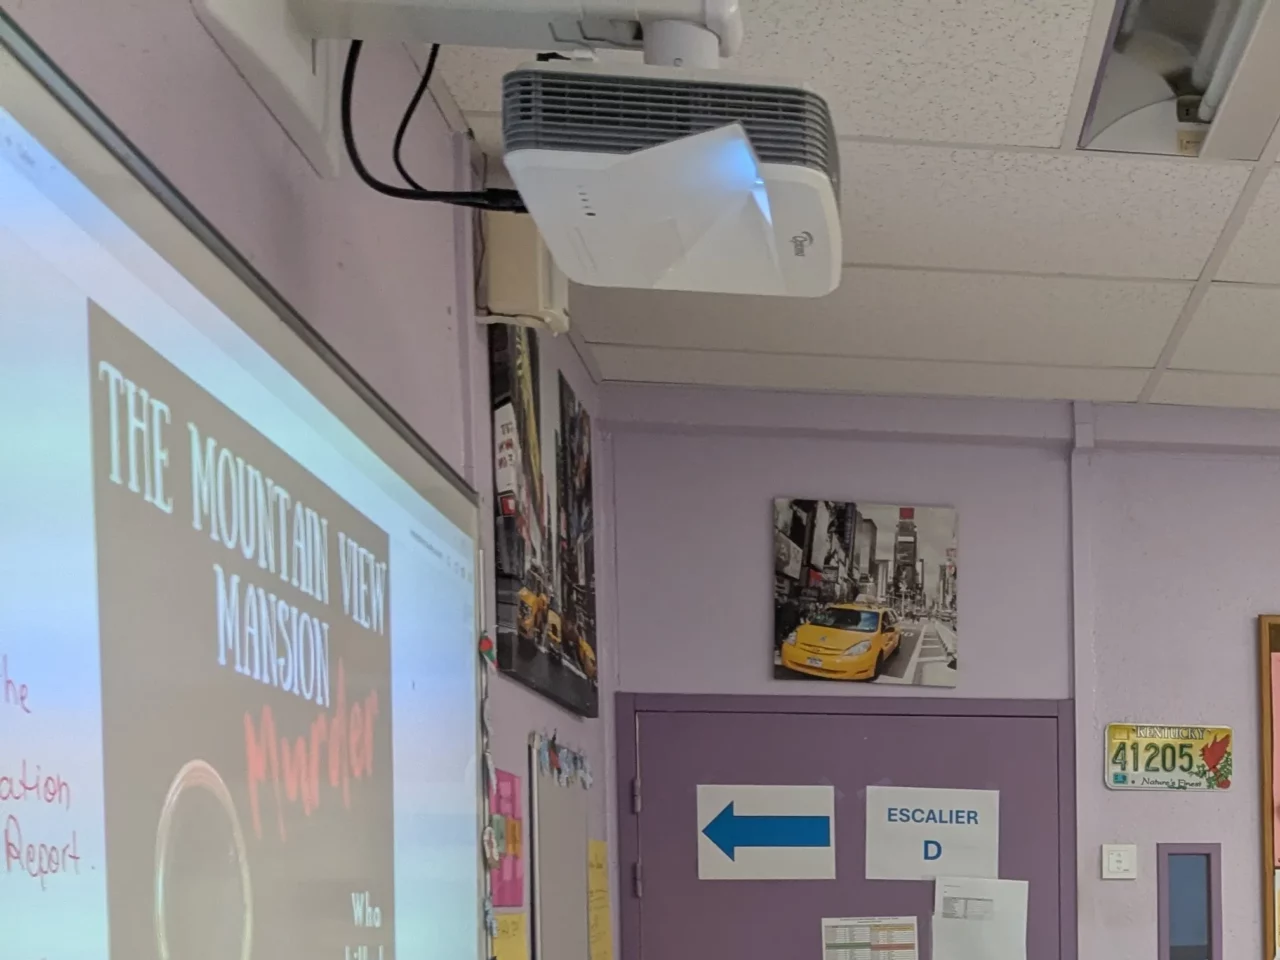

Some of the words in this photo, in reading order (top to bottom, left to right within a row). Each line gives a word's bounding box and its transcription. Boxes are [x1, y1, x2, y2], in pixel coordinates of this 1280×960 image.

[98, 360, 173, 514] THE
[187, 422, 329, 605] MOUNTAIN
[337, 531, 387, 636] VIEW
[213, 563, 329, 708] MANSION
[0, 653, 32, 714] he
[243, 656, 379, 843] Murder
[1136, 726, 1206, 740] KENTUCKY
[1111, 741, 1194, 772] 41205
[1140, 776, 1176, 787] Nature's
[1178, 778, 1202, 788] Finest
[887, 807, 979, 825] ESCALIER
[923, 840, 943, 861] D
[351, 891, 381, 928] Who
